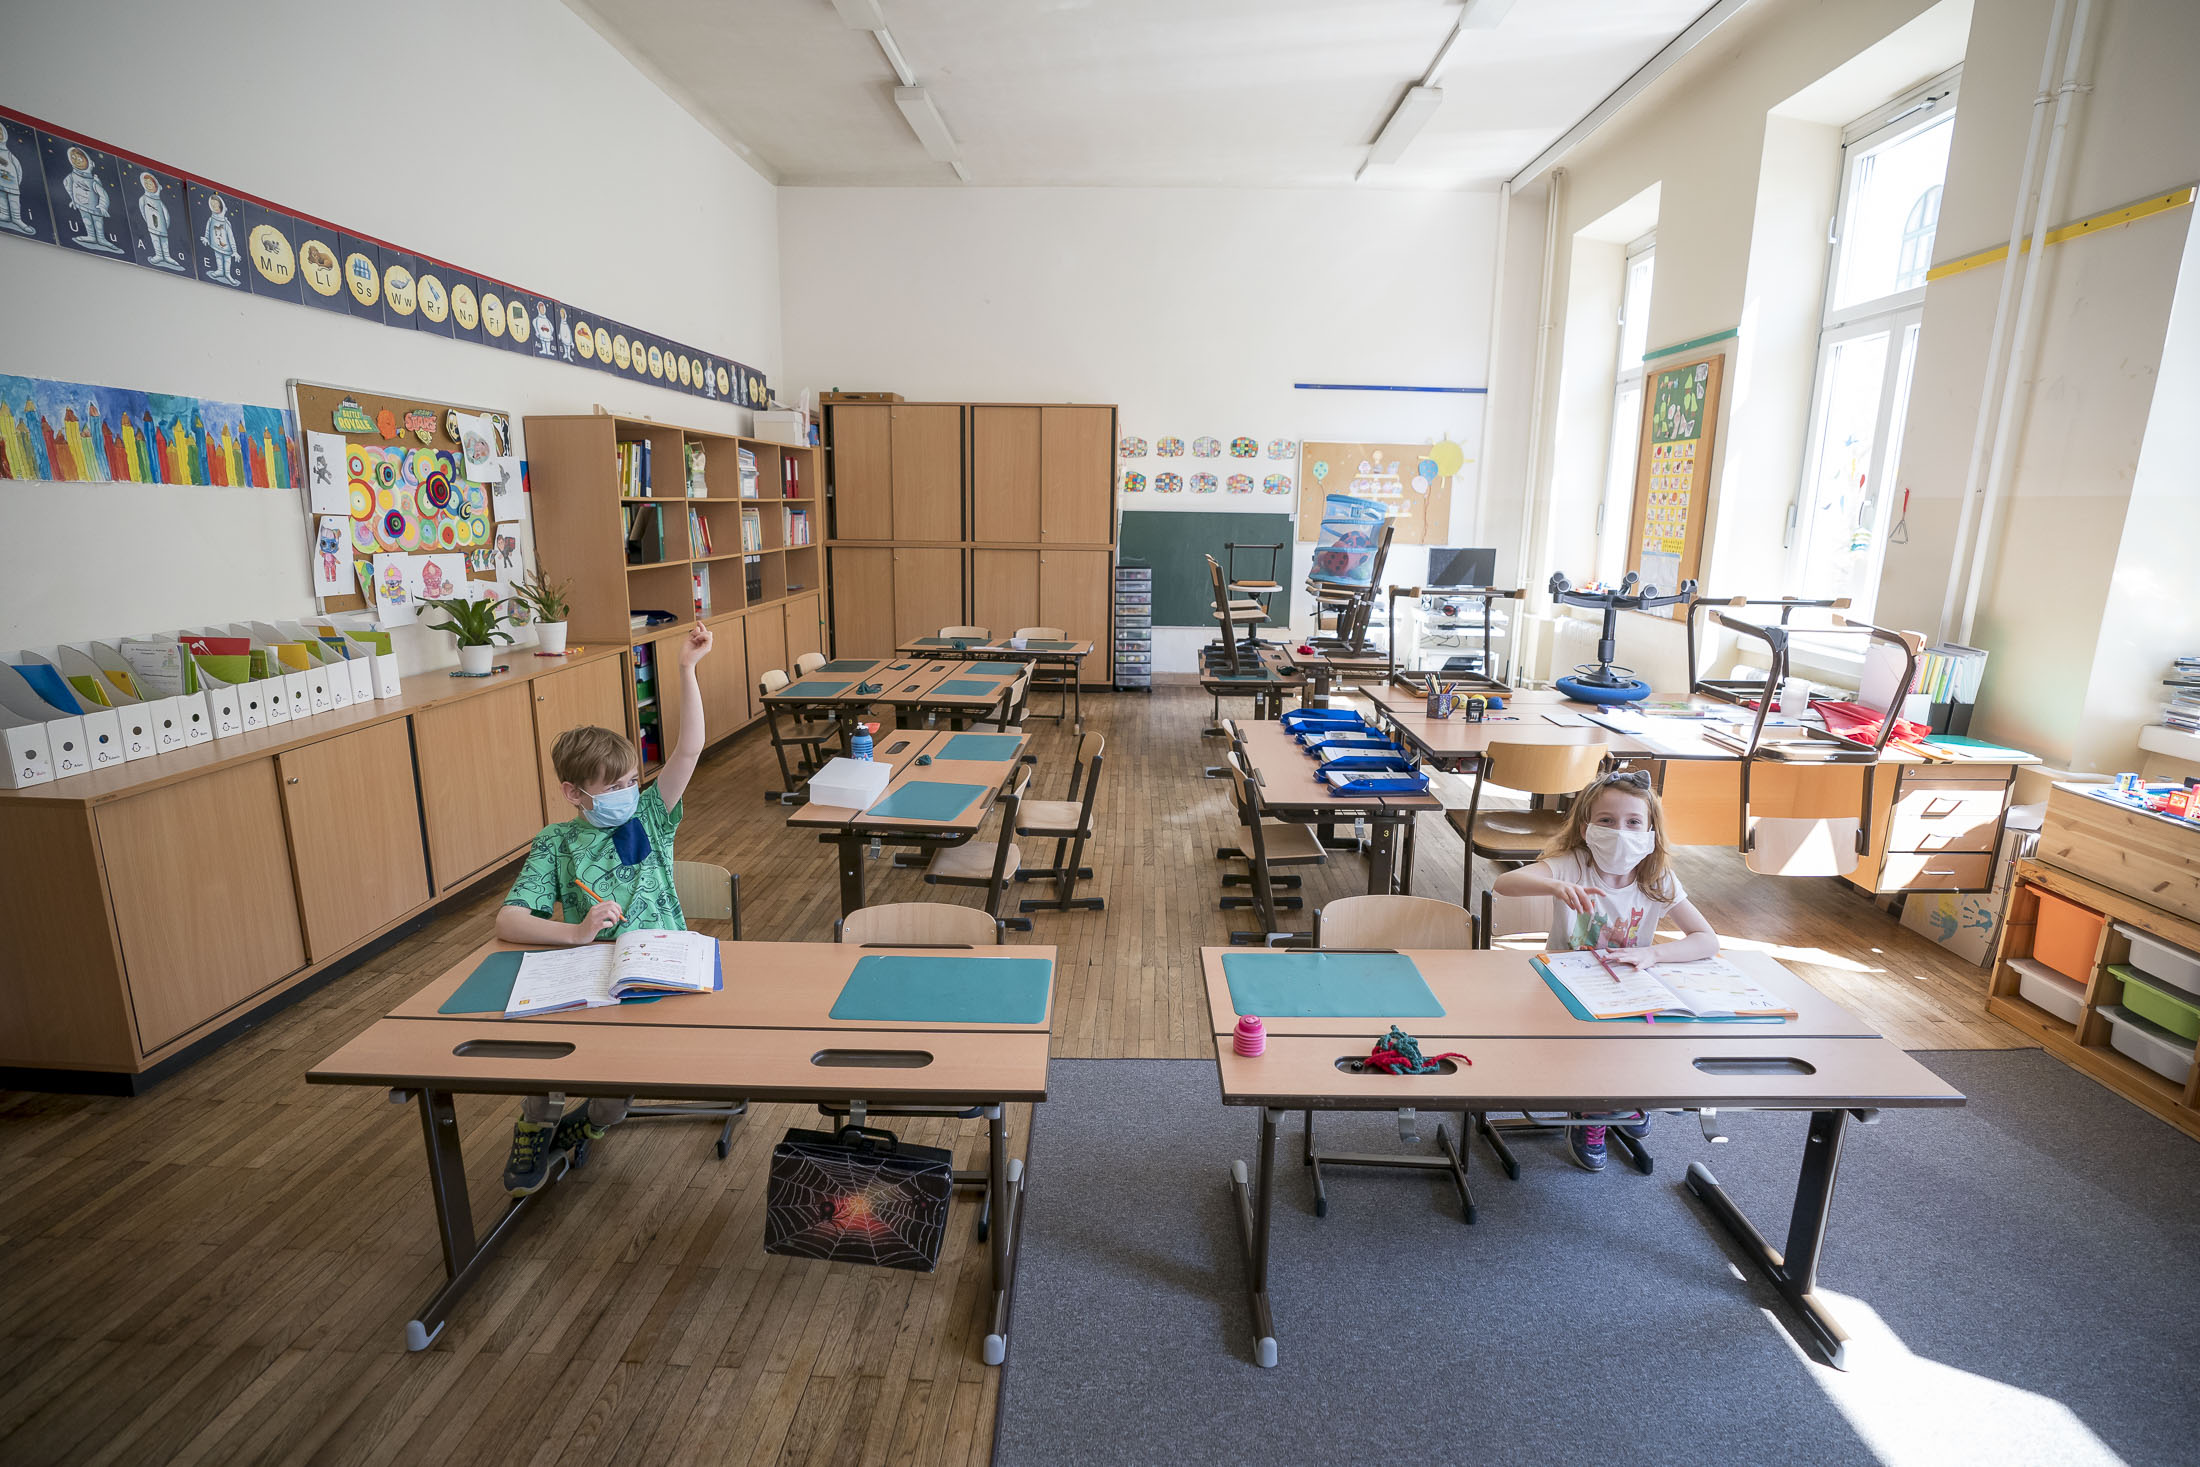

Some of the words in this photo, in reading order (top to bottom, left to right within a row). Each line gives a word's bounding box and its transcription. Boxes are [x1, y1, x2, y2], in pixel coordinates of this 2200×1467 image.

[69, 220, 79, 232] U
[109, 233, 118, 242] u
[137, 239, 146, 250] A
[203, 257, 211, 268] E
[338, 416, 372, 430] ROYALE
[1383, 829, 1390, 838] 3
